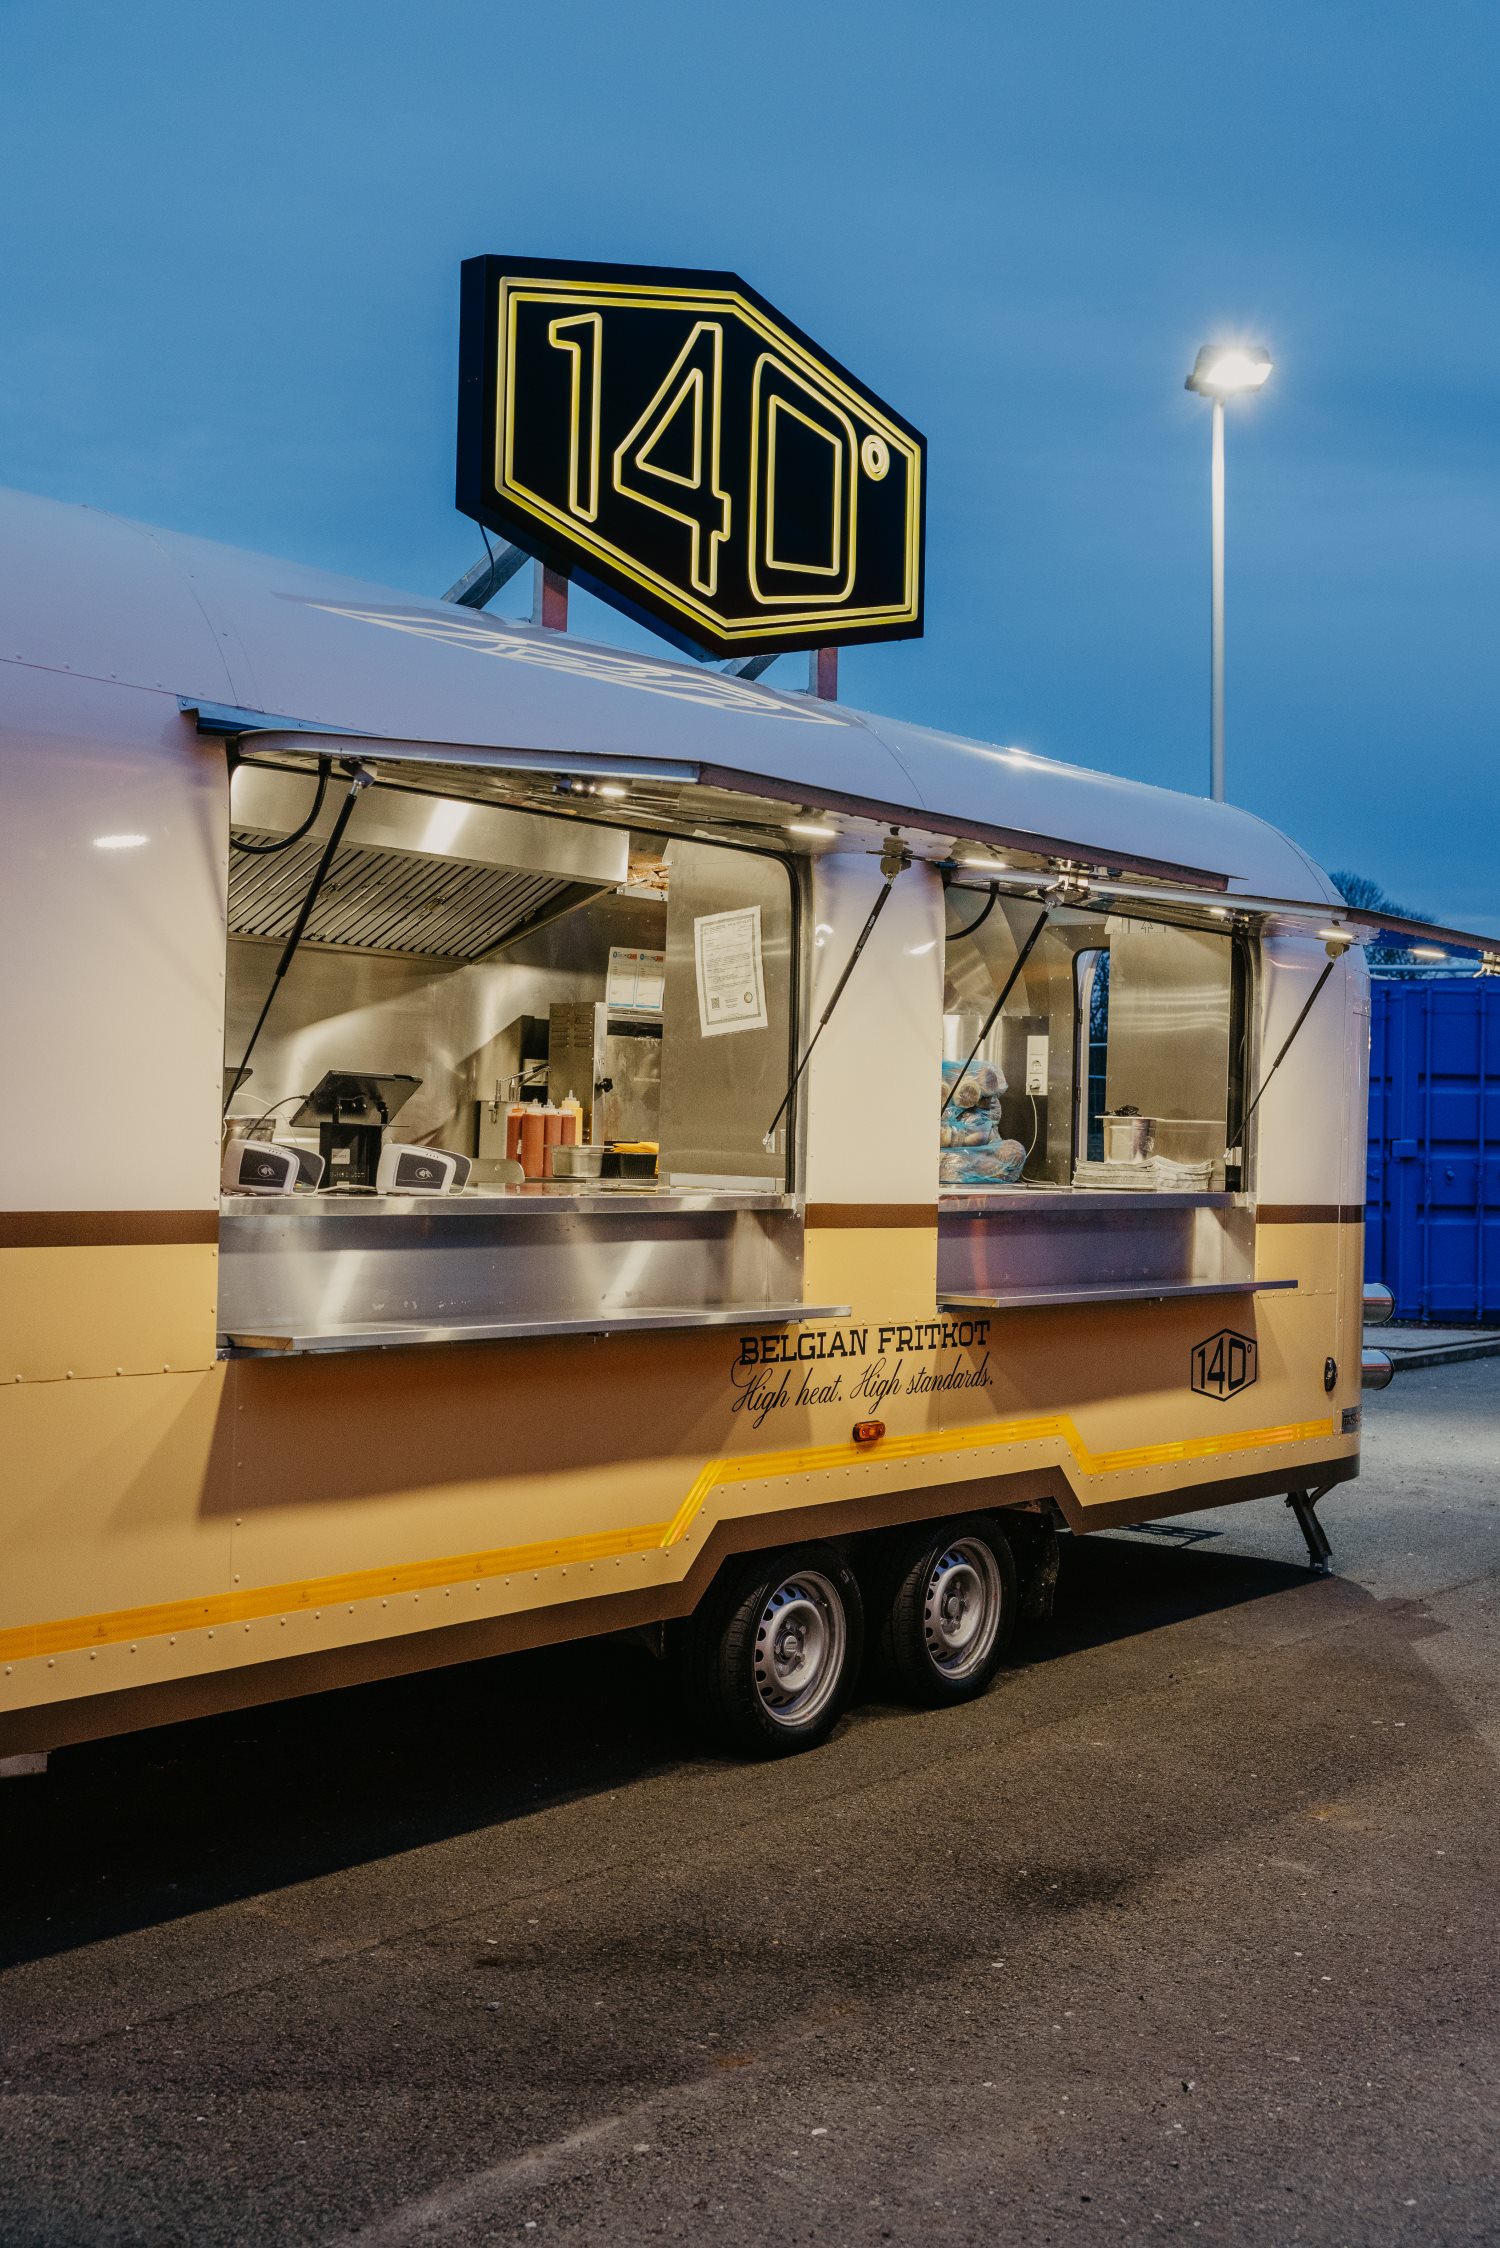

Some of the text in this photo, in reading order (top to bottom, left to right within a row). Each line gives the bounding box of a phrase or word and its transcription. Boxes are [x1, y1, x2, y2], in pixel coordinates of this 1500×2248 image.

[739, 1320, 990, 1365] BELGIAN FRITKOT
[731, 1351, 994, 1429] High heat. High standards.
